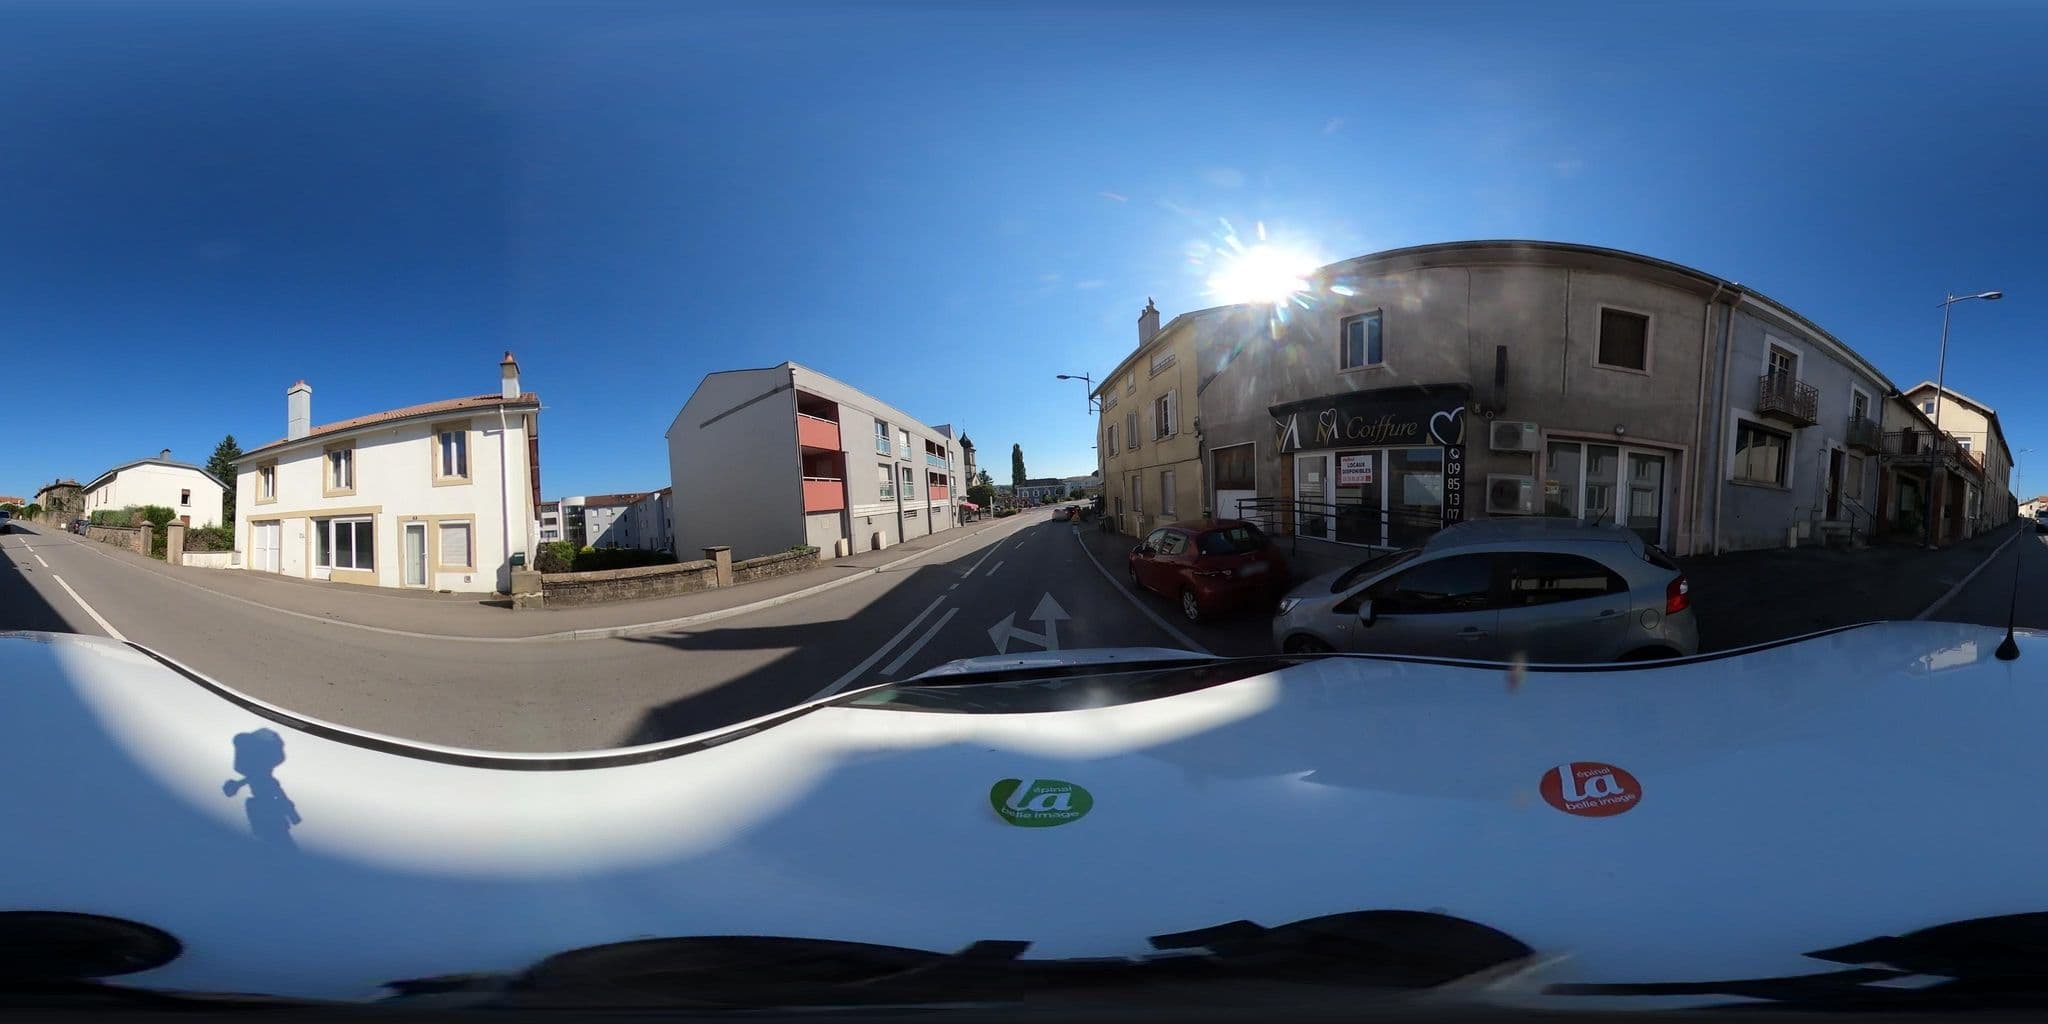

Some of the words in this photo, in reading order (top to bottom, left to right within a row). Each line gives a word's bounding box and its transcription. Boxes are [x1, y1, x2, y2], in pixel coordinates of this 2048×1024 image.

[1346, 414, 1418, 442] Coiffure
[1447, 462, 1461, 475] 09
[1447, 478, 1460, 490] 85
[1448, 493, 1460, 506] 13
[1446, 508, 1460, 520] 07
[1565, 799, 1598, 810] belle
[1599, 793, 1636, 807] image
[1033, 810, 1080, 819] image
